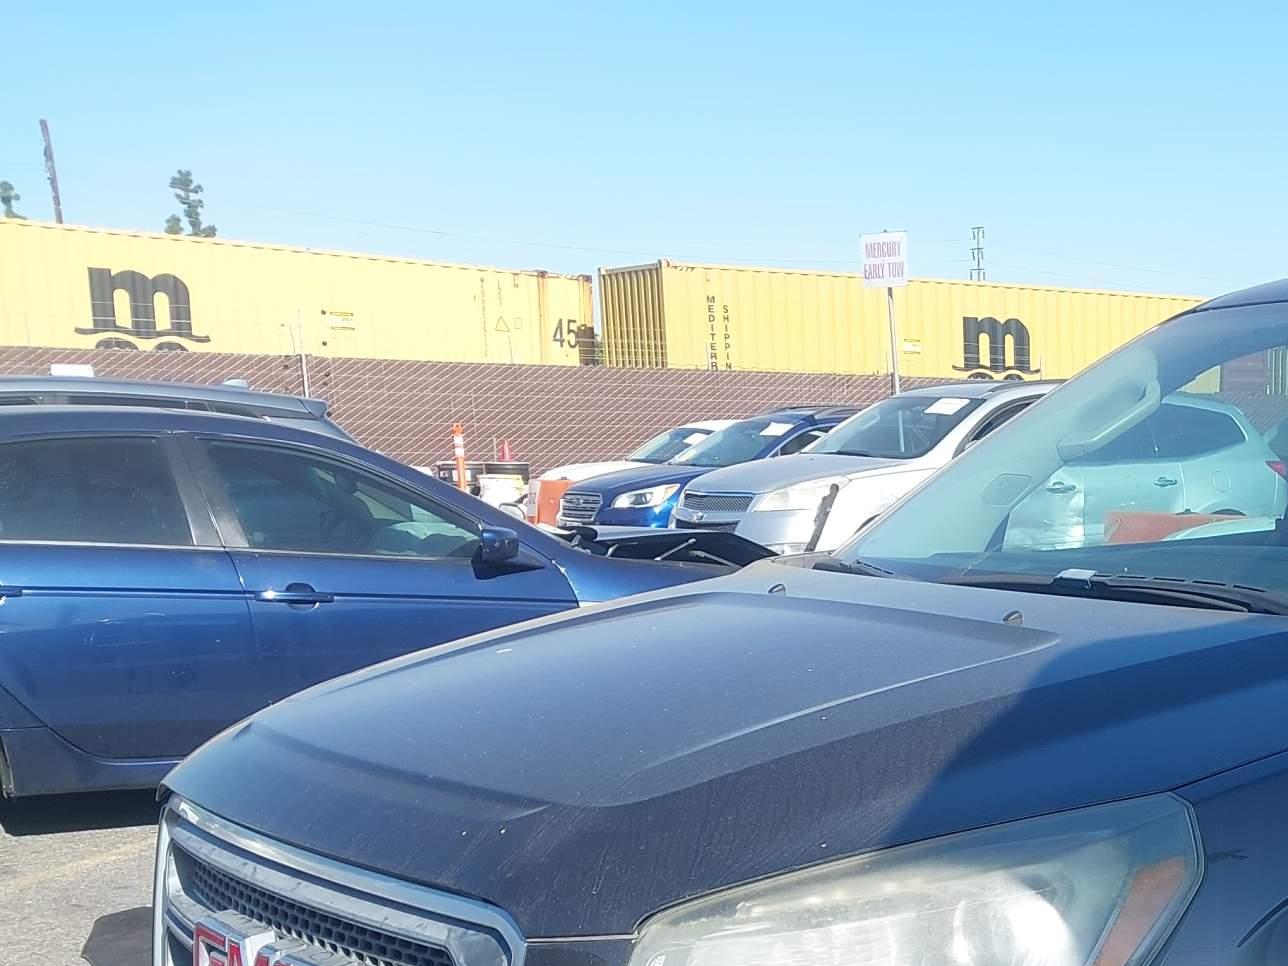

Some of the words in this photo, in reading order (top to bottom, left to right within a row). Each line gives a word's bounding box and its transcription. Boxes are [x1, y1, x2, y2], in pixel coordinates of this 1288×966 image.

[865, 240, 901, 259] MERCURY
[864, 262, 885, 280] EARLY
[887, 261, 905, 279] TOW
[552, 318, 578, 348] 45
